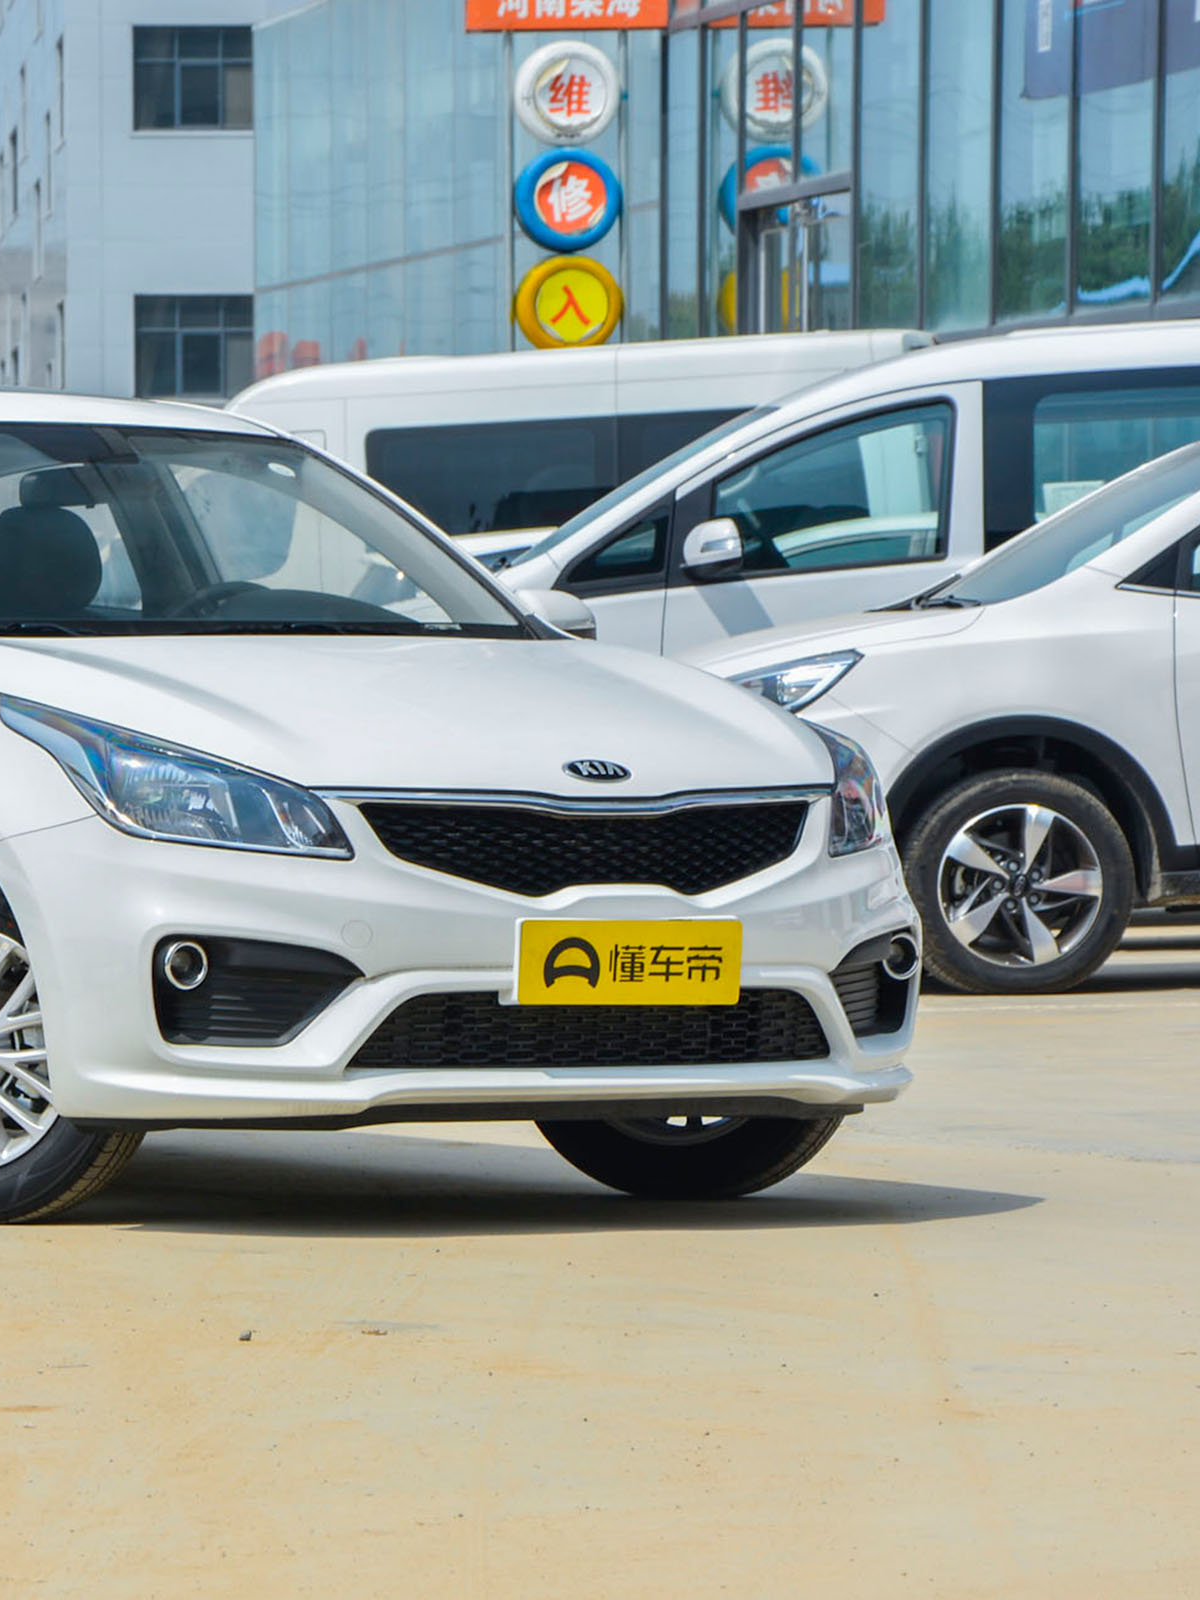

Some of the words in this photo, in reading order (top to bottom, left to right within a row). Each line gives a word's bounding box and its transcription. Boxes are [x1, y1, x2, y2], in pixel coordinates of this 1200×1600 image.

[549, 73, 591, 117] 维
[549, 174, 593, 222] 修
[550, 285, 591, 325] 入
[575, 761, 625, 776] KIA
[609, 943, 723, 982] 懂车帝
